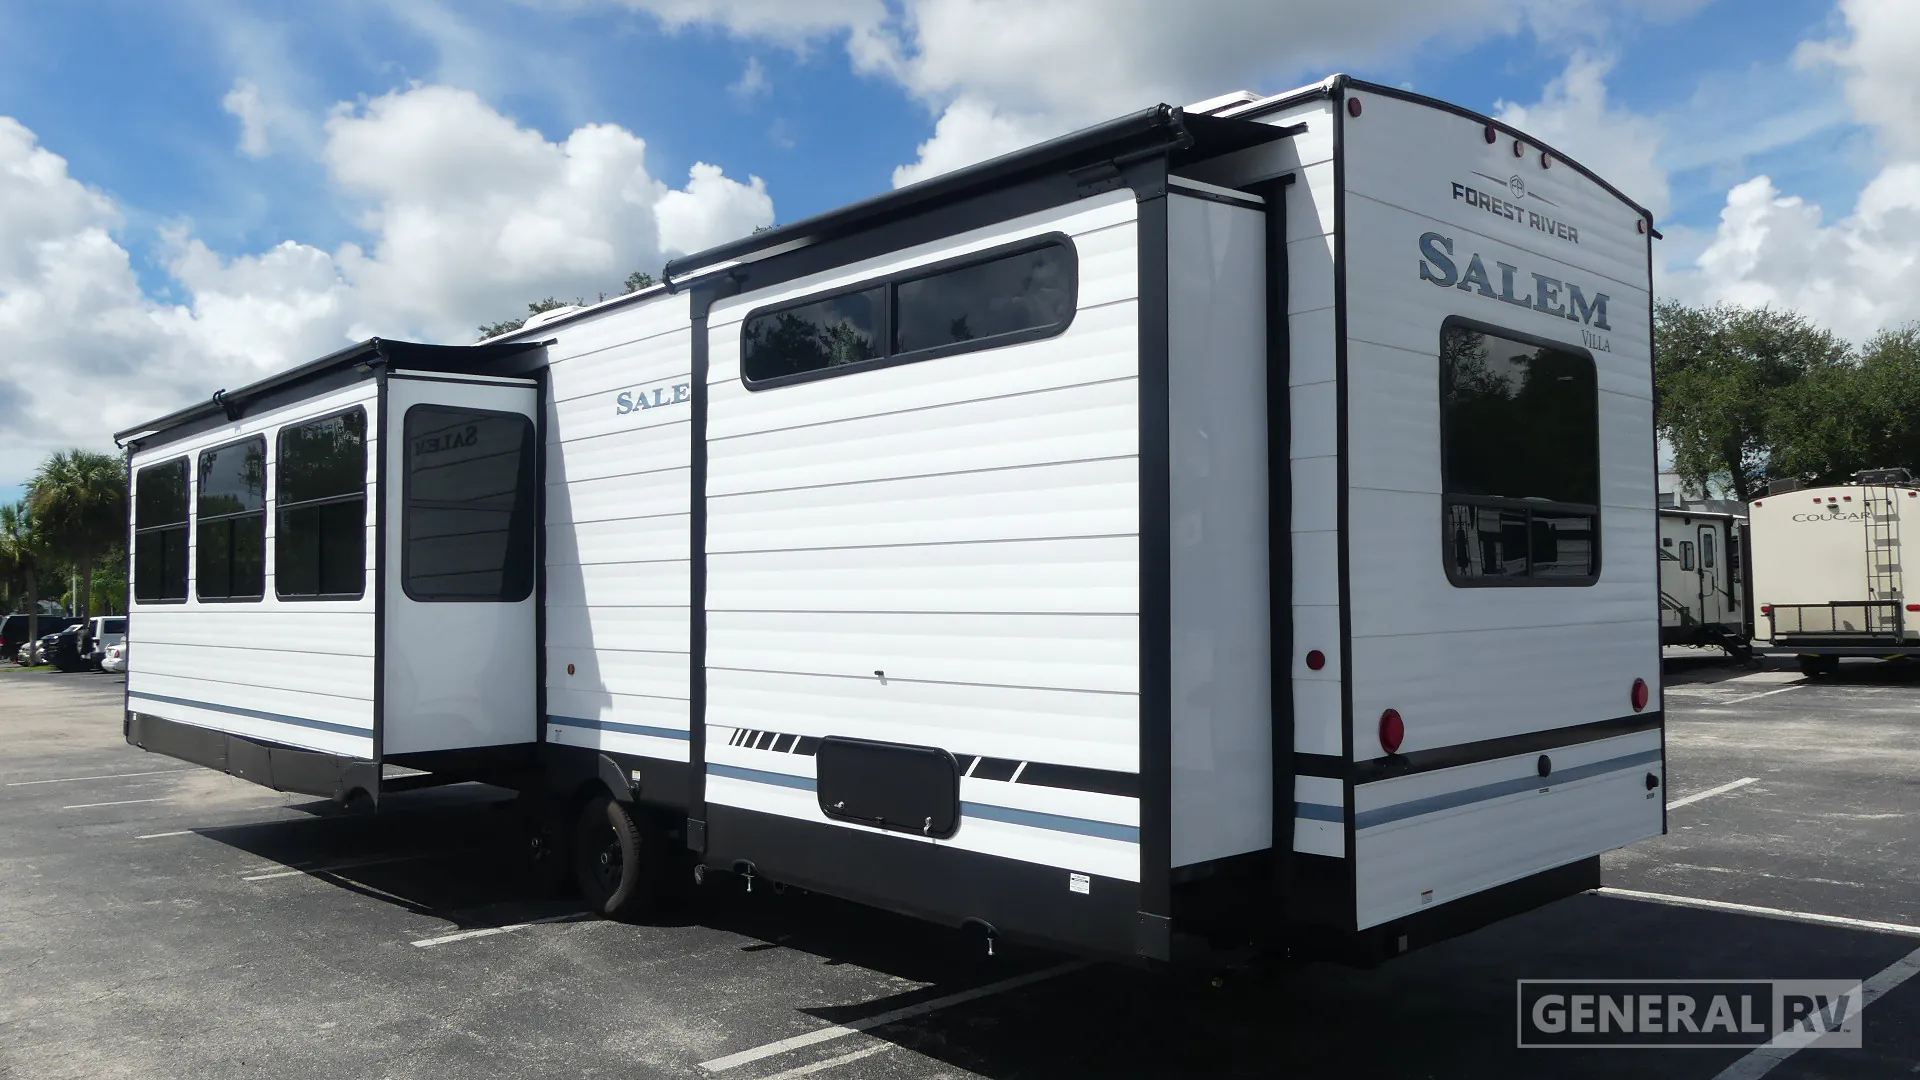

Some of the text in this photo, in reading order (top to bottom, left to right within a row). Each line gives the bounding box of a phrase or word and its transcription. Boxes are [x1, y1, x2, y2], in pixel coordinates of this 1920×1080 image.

[1451, 181, 1579, 244] FOREST RIVER
[1418, 231, 1612, 332] SALEM
[1581, 329, 1611, 353] VILLA
[1792, 511, 1872, 523] COUGAR
